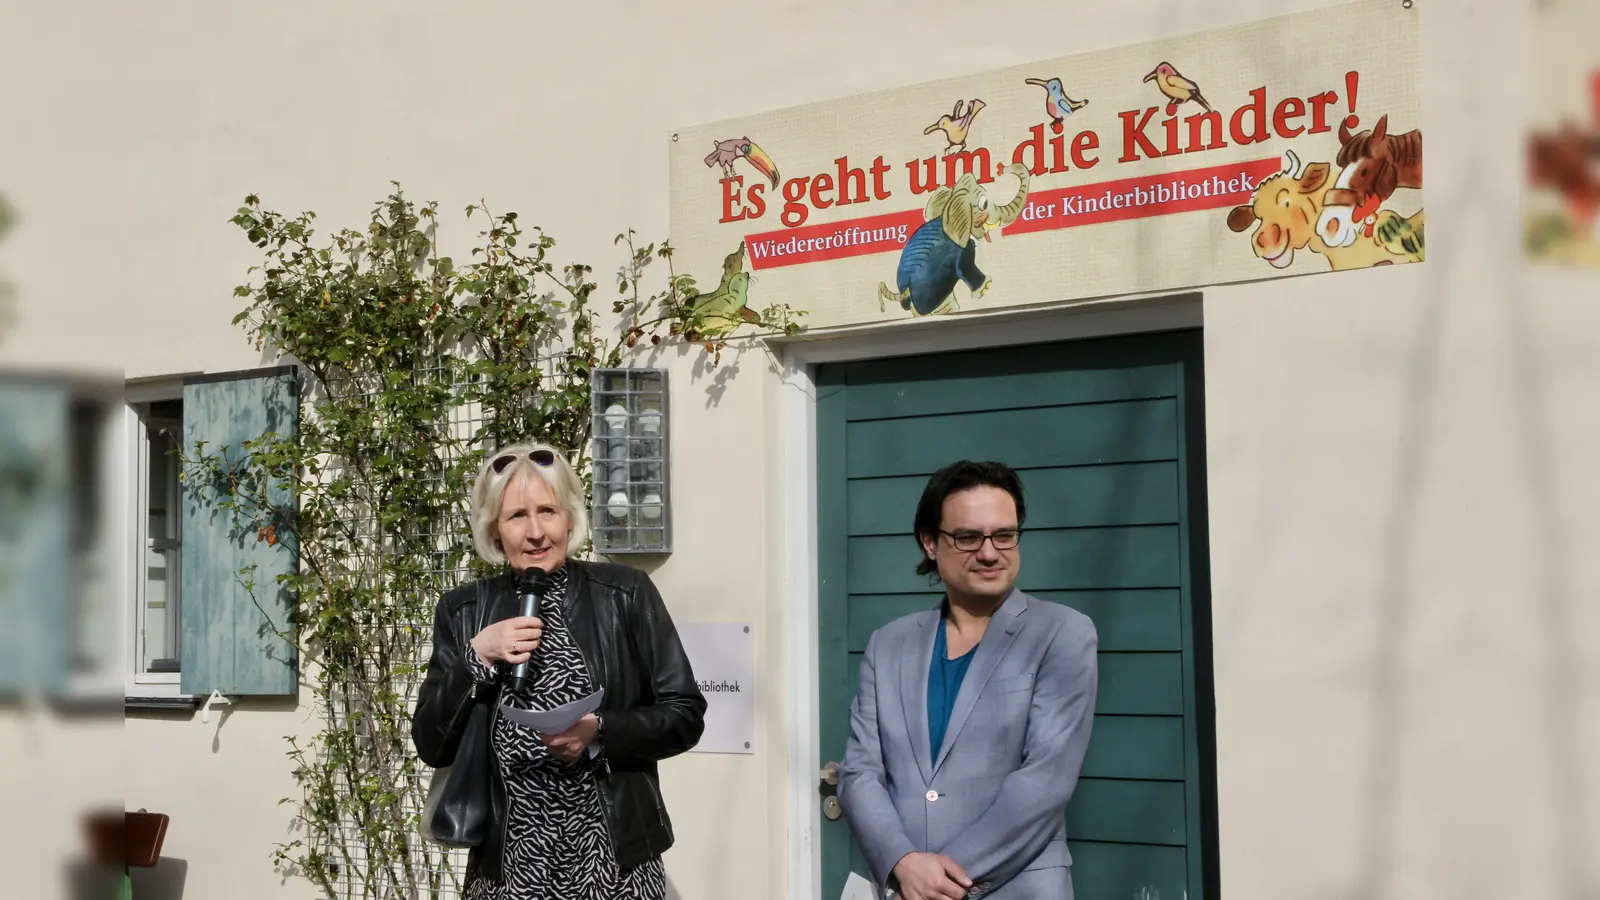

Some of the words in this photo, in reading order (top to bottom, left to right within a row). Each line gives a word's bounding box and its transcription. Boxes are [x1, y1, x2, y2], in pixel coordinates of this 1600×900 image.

[718, 174, 765, 224] Es
[780, 155, 892, 228] geht
[905, 147, 995, 195] um
[1011, 120, 1100, 177] die
[1117, 70, 1360, 164] Kinder!
[751, 223, 908, 260] Wiedereröffnung
[1021, 201, 1056, 221] der
[1061, 171, 1255, 216] Kinderbibliothek
